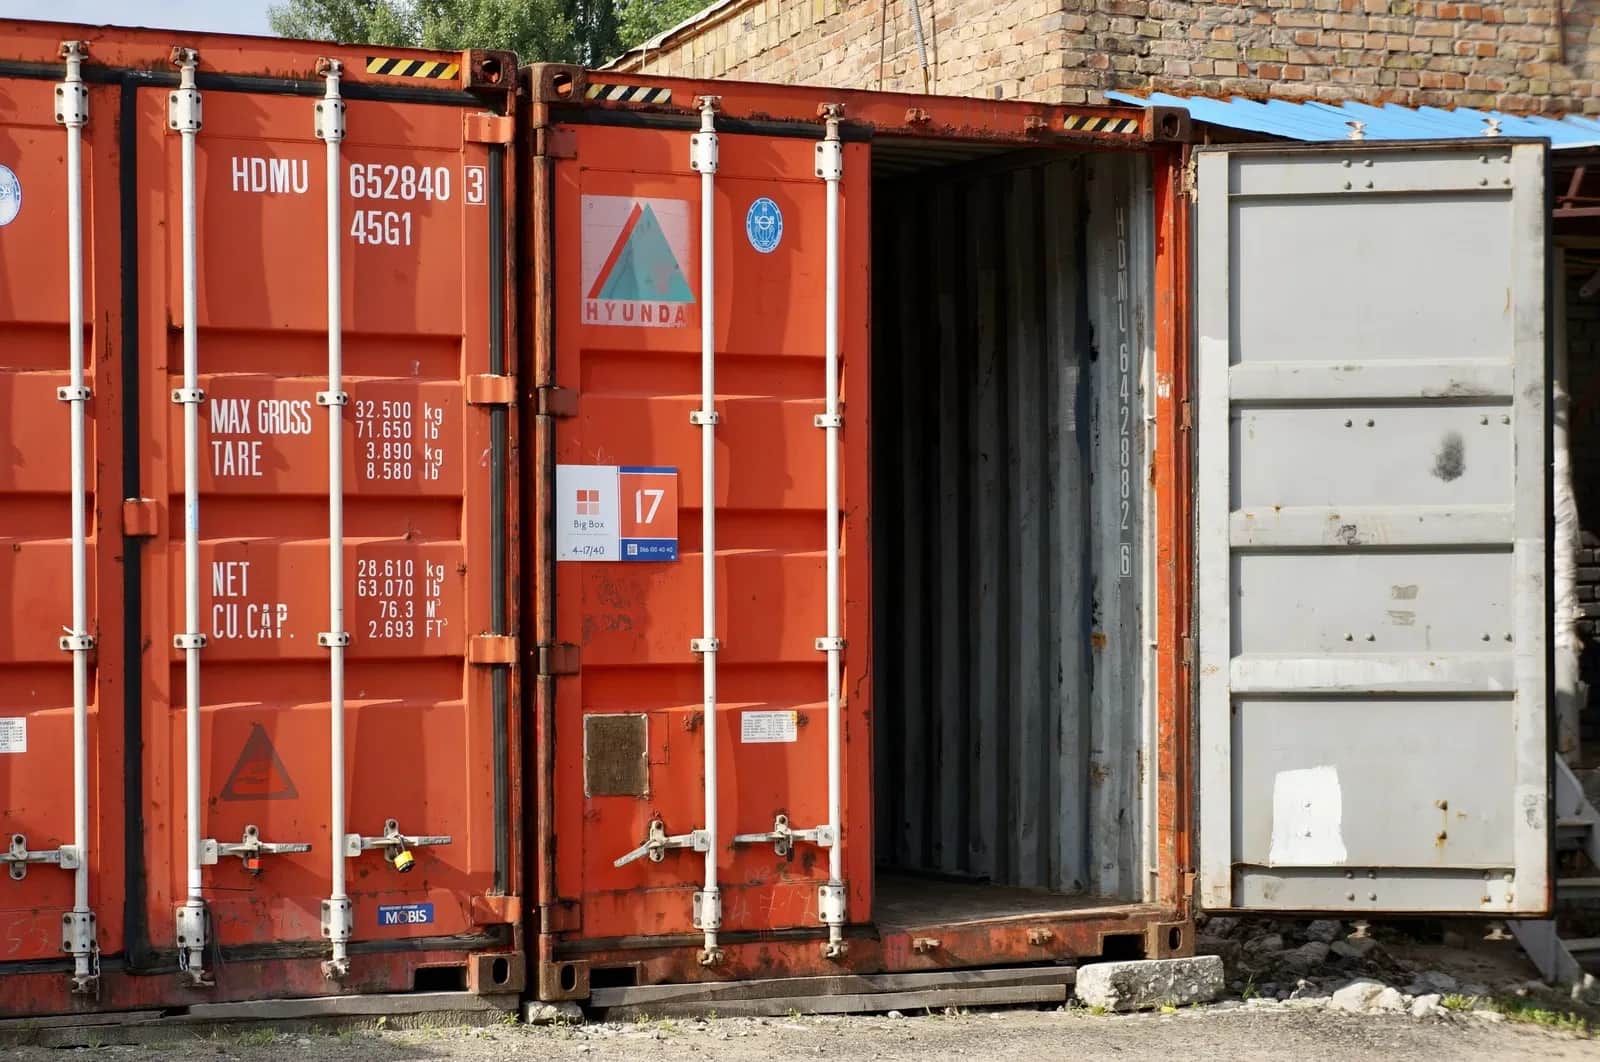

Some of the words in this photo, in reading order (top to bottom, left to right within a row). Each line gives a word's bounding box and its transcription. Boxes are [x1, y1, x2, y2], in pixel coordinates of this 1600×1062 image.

[231, 156, 309, 194] HDMU
[349, 163, 451, 201] 652840
[466, 167, 484, 203] 3
[350, 209, 412, 246] 45G1
[210, 398, 251, 434] MAX
[257, 399, 312, 435] GROSS
[424, 401, 443, 425] kg
[424, 421, 439, 439] lb
[211, 440, 263, 476] TARE
[424, 442, 443, 466] kg
[424, 462, 439, 480] lb
[635, 488, 665, 525] 17
[573, 519, 587, 531] Big
[588, 519, 605, 529] Box
[212, 561, 250, 597] NET
[425, 559, 445, 583] kg
[425, 579, 440, 597] lb
[378, 600, 414, 618] 76.3
[384, 909, 428, 924] MOBIS
